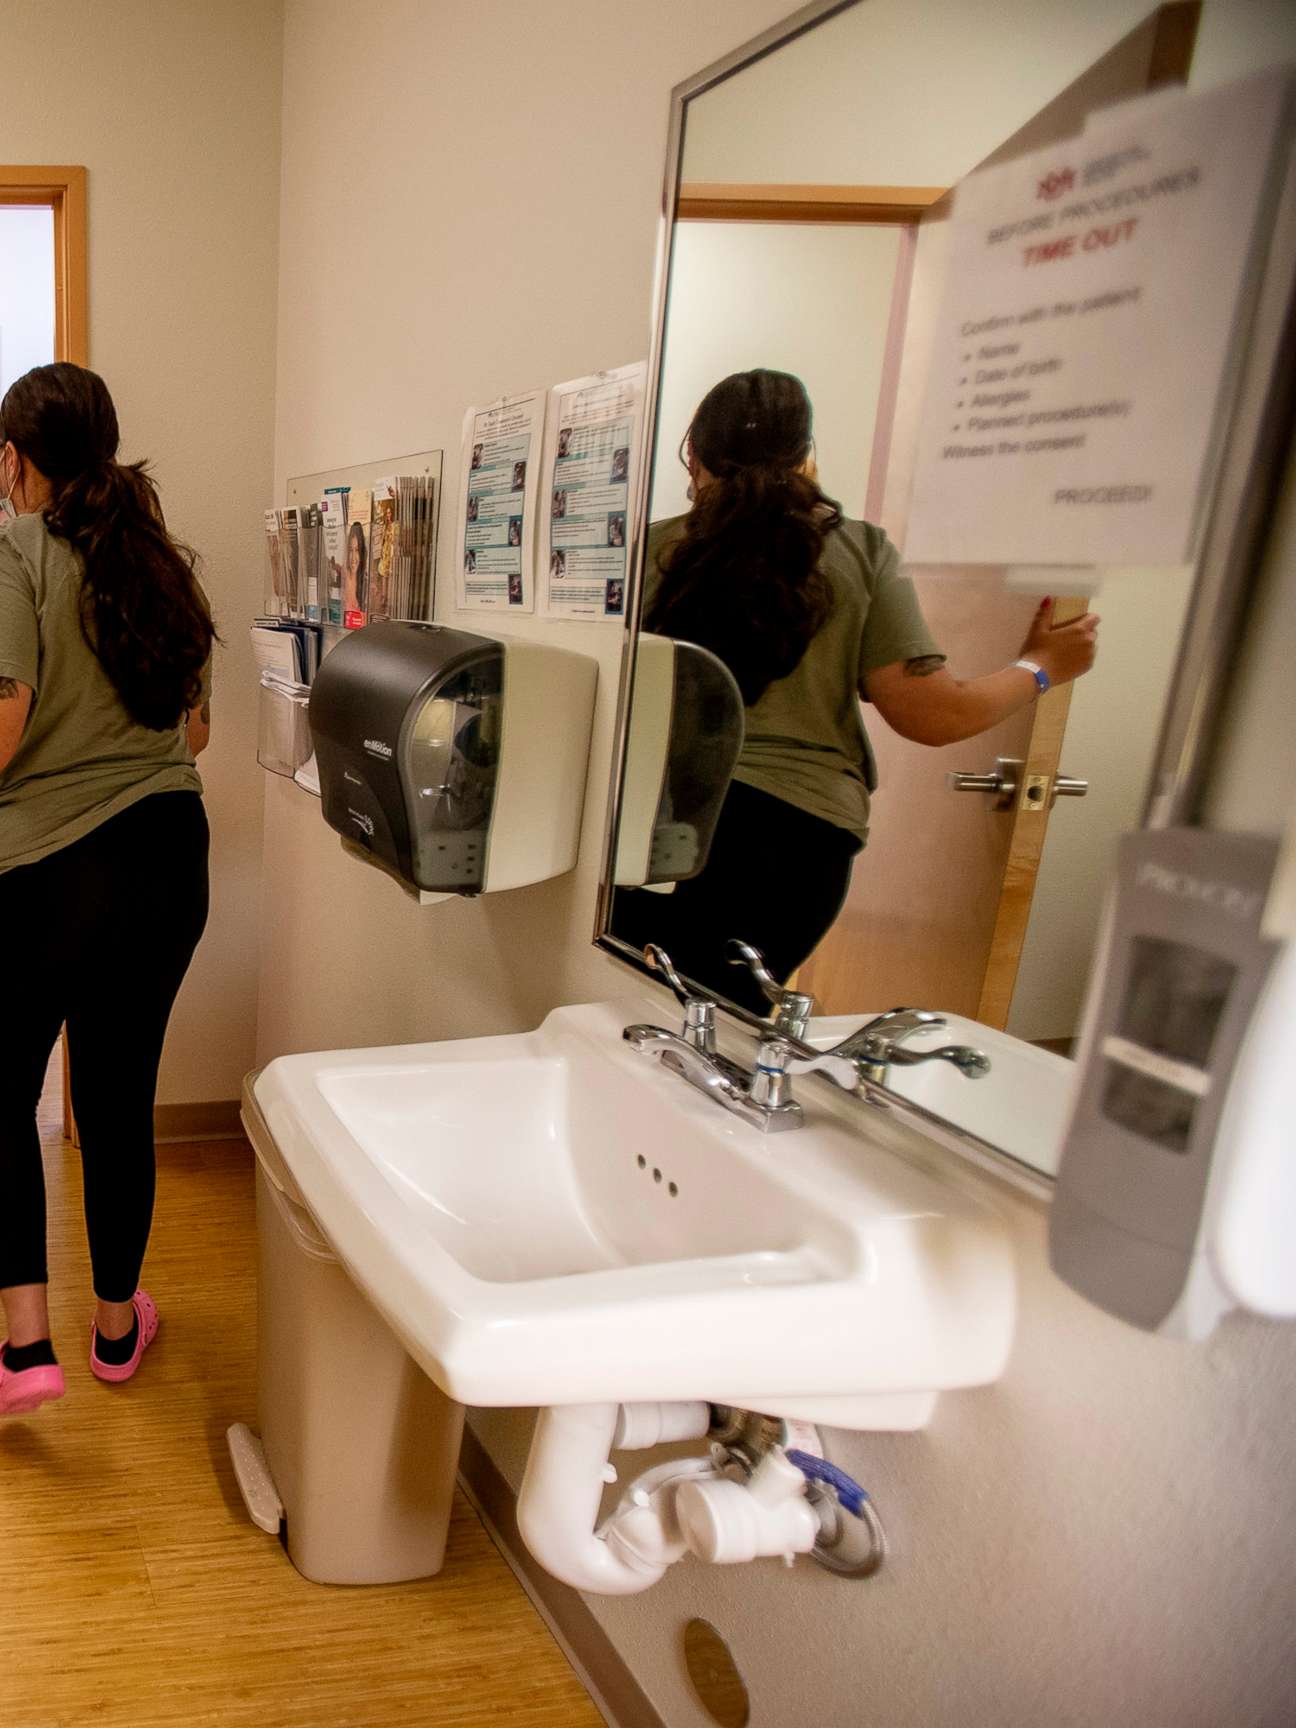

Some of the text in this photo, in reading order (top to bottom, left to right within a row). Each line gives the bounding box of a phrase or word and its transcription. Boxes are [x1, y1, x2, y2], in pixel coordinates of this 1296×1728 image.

[987, 212, 1055, 245] BEFORE
[1024, 217, 1140, 267] TIME OUT
[961, 315, 1014, 336] Confirm
[1017, 307, 1046, 325] with
[1051, 302, 1076, 317] the
[977, 343, 1020, 359] Name
[975, 358, 1062, 384] Date of birth
[970, 390, 1031, 409] Allergies
[967, 414, 1024, 431] Planned
[942, 434, 1088, 459] Witness the consent
